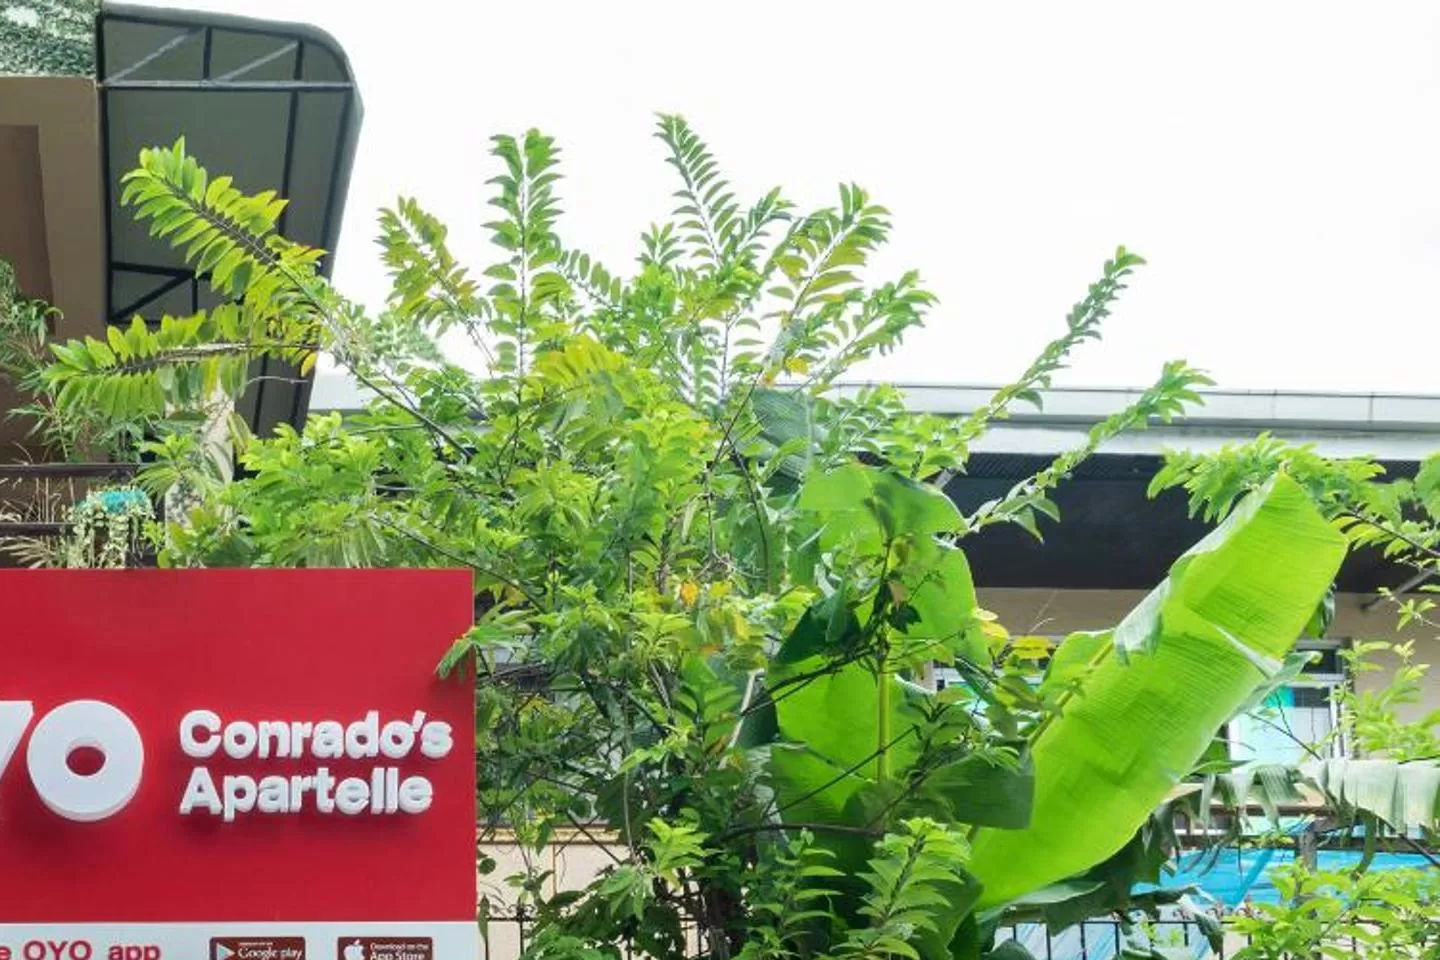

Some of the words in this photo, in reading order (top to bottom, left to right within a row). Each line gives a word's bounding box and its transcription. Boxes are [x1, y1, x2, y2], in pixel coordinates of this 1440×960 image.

[179, 709, 454, 759] Conrado's
[179, 767, 434, 822] Apartelle
[238, 946, 278, 960] Google
[280, 947, 303, 960] play
